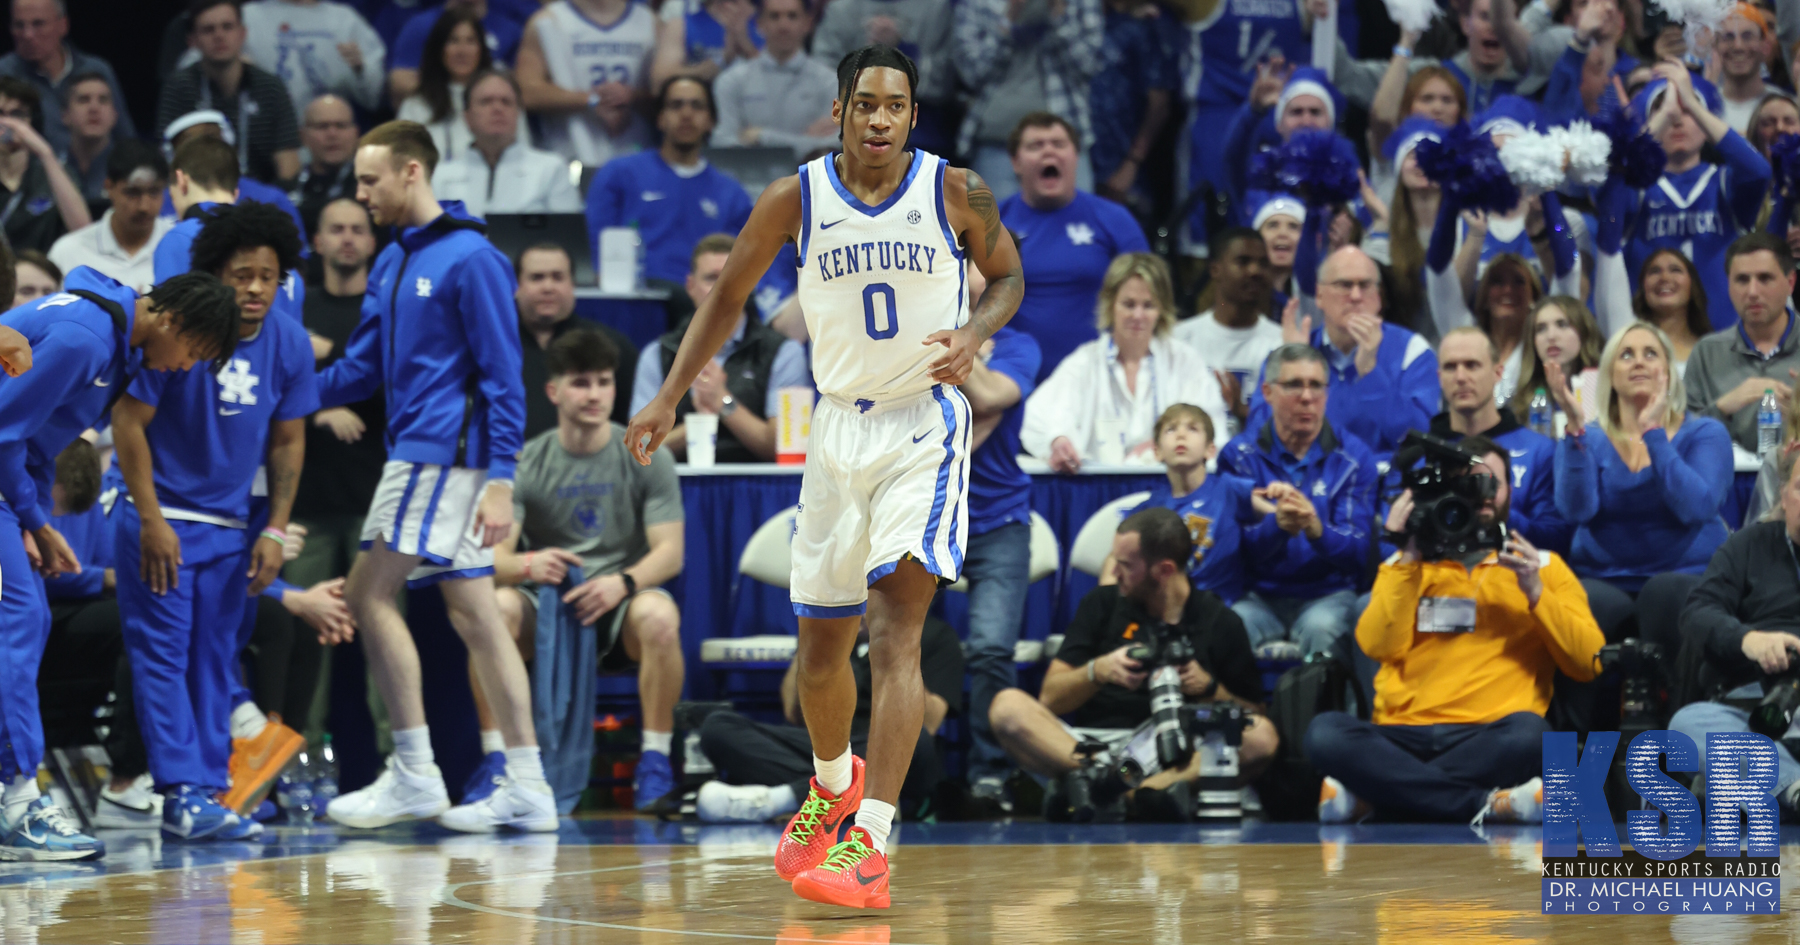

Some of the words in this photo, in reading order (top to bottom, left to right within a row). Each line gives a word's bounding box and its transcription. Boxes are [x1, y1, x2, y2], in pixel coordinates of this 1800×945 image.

[907, 210, 921, 224] SEC
[1646, 211, 1724, 241] KENTUCKY
[817, 241, 937, 282] KENTUCKY
[862, 282, 899, 341] 0
[723, 647, 797, 661] KENTUCK
